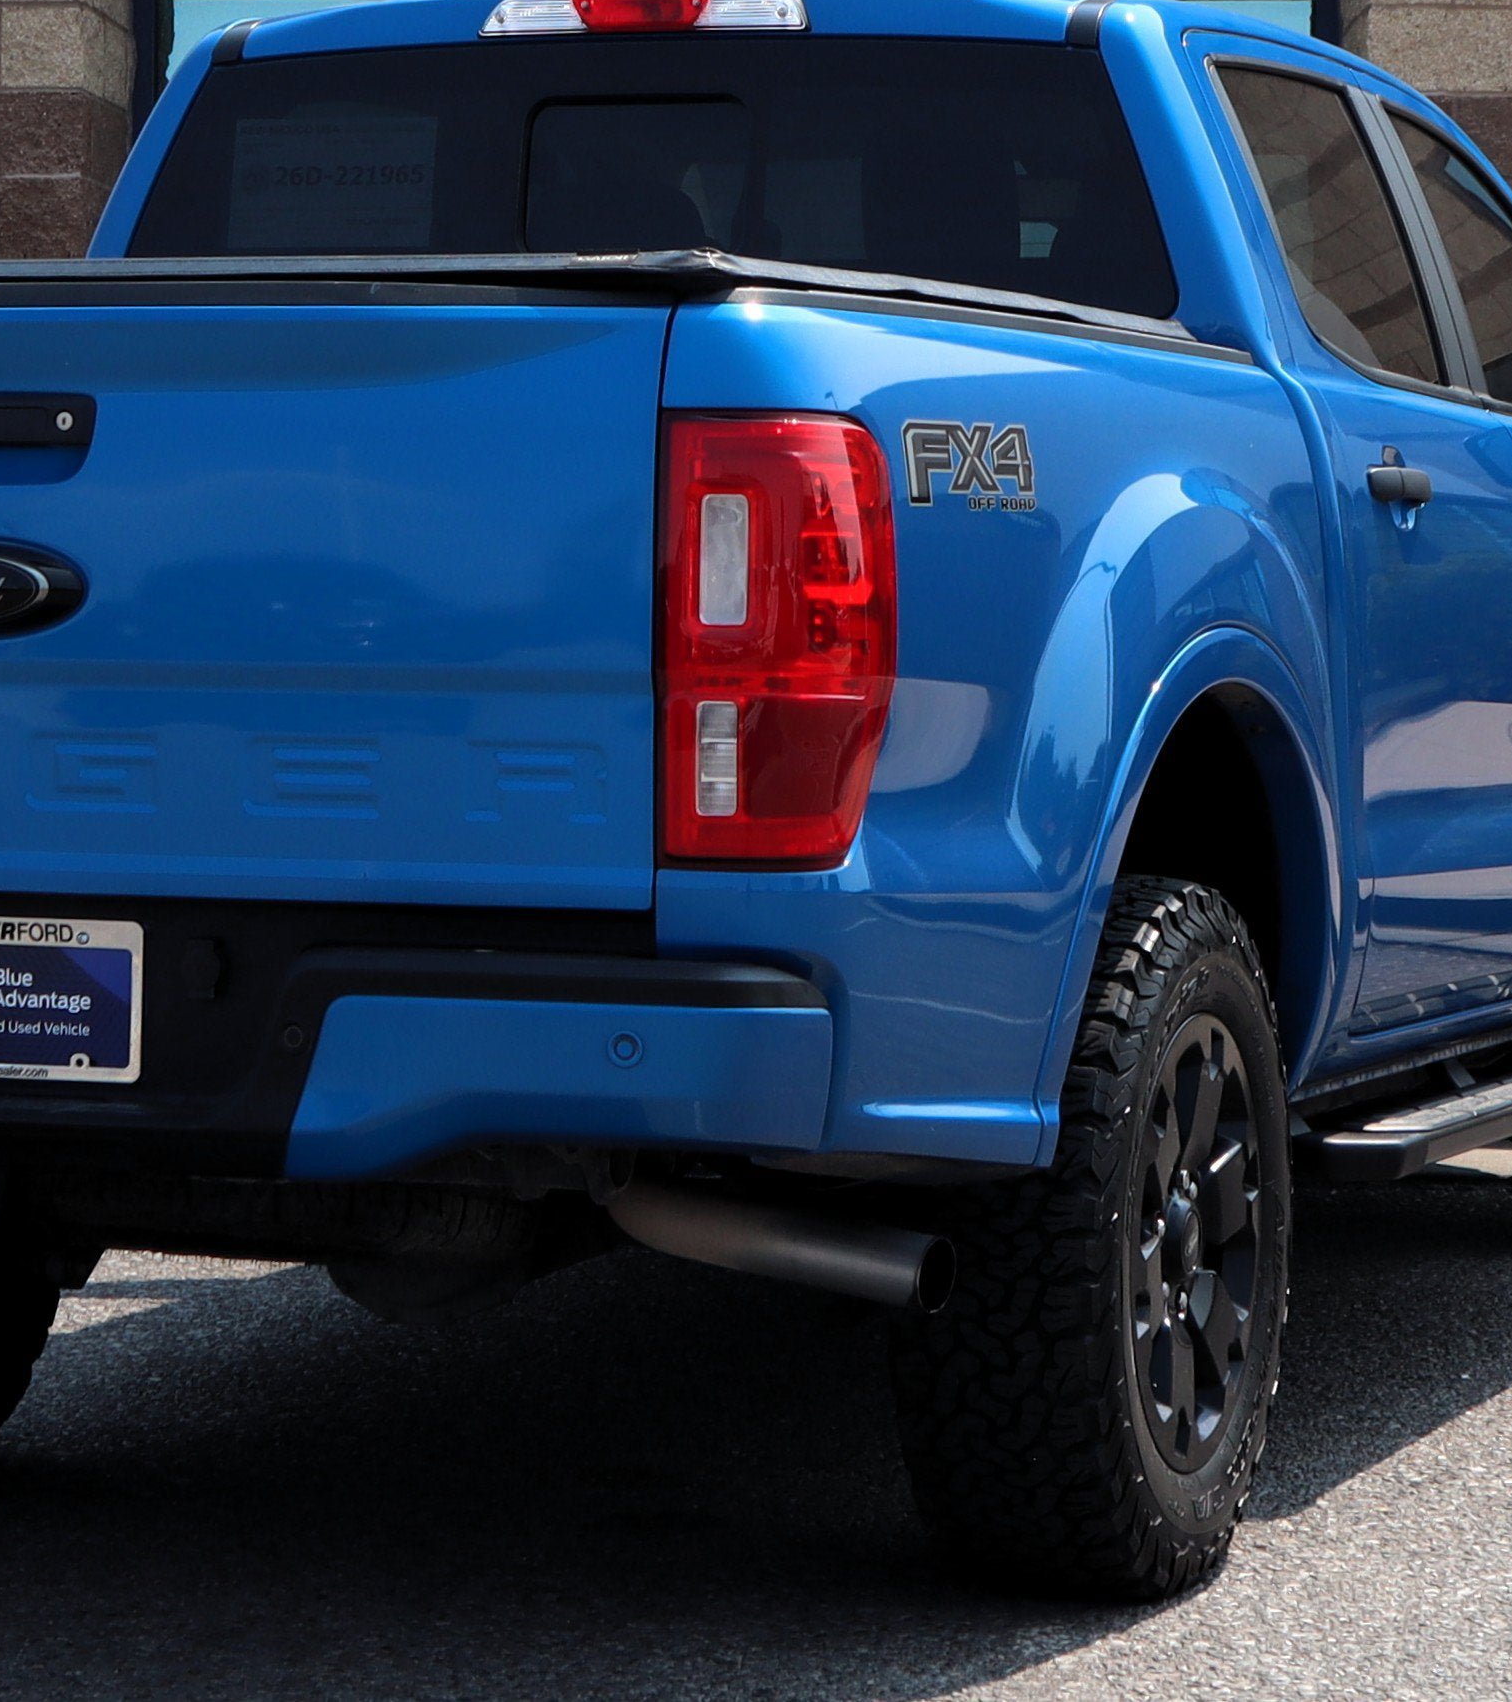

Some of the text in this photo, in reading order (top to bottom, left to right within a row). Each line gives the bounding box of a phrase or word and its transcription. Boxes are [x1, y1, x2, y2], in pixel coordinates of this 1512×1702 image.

[901, 419, 1035, 507] FX4
[968, 496, 1037, 512] OFF ROAD
[8, 1020, 41, 1035] Used
[44, 1021, 90, 1037] Vehicle
